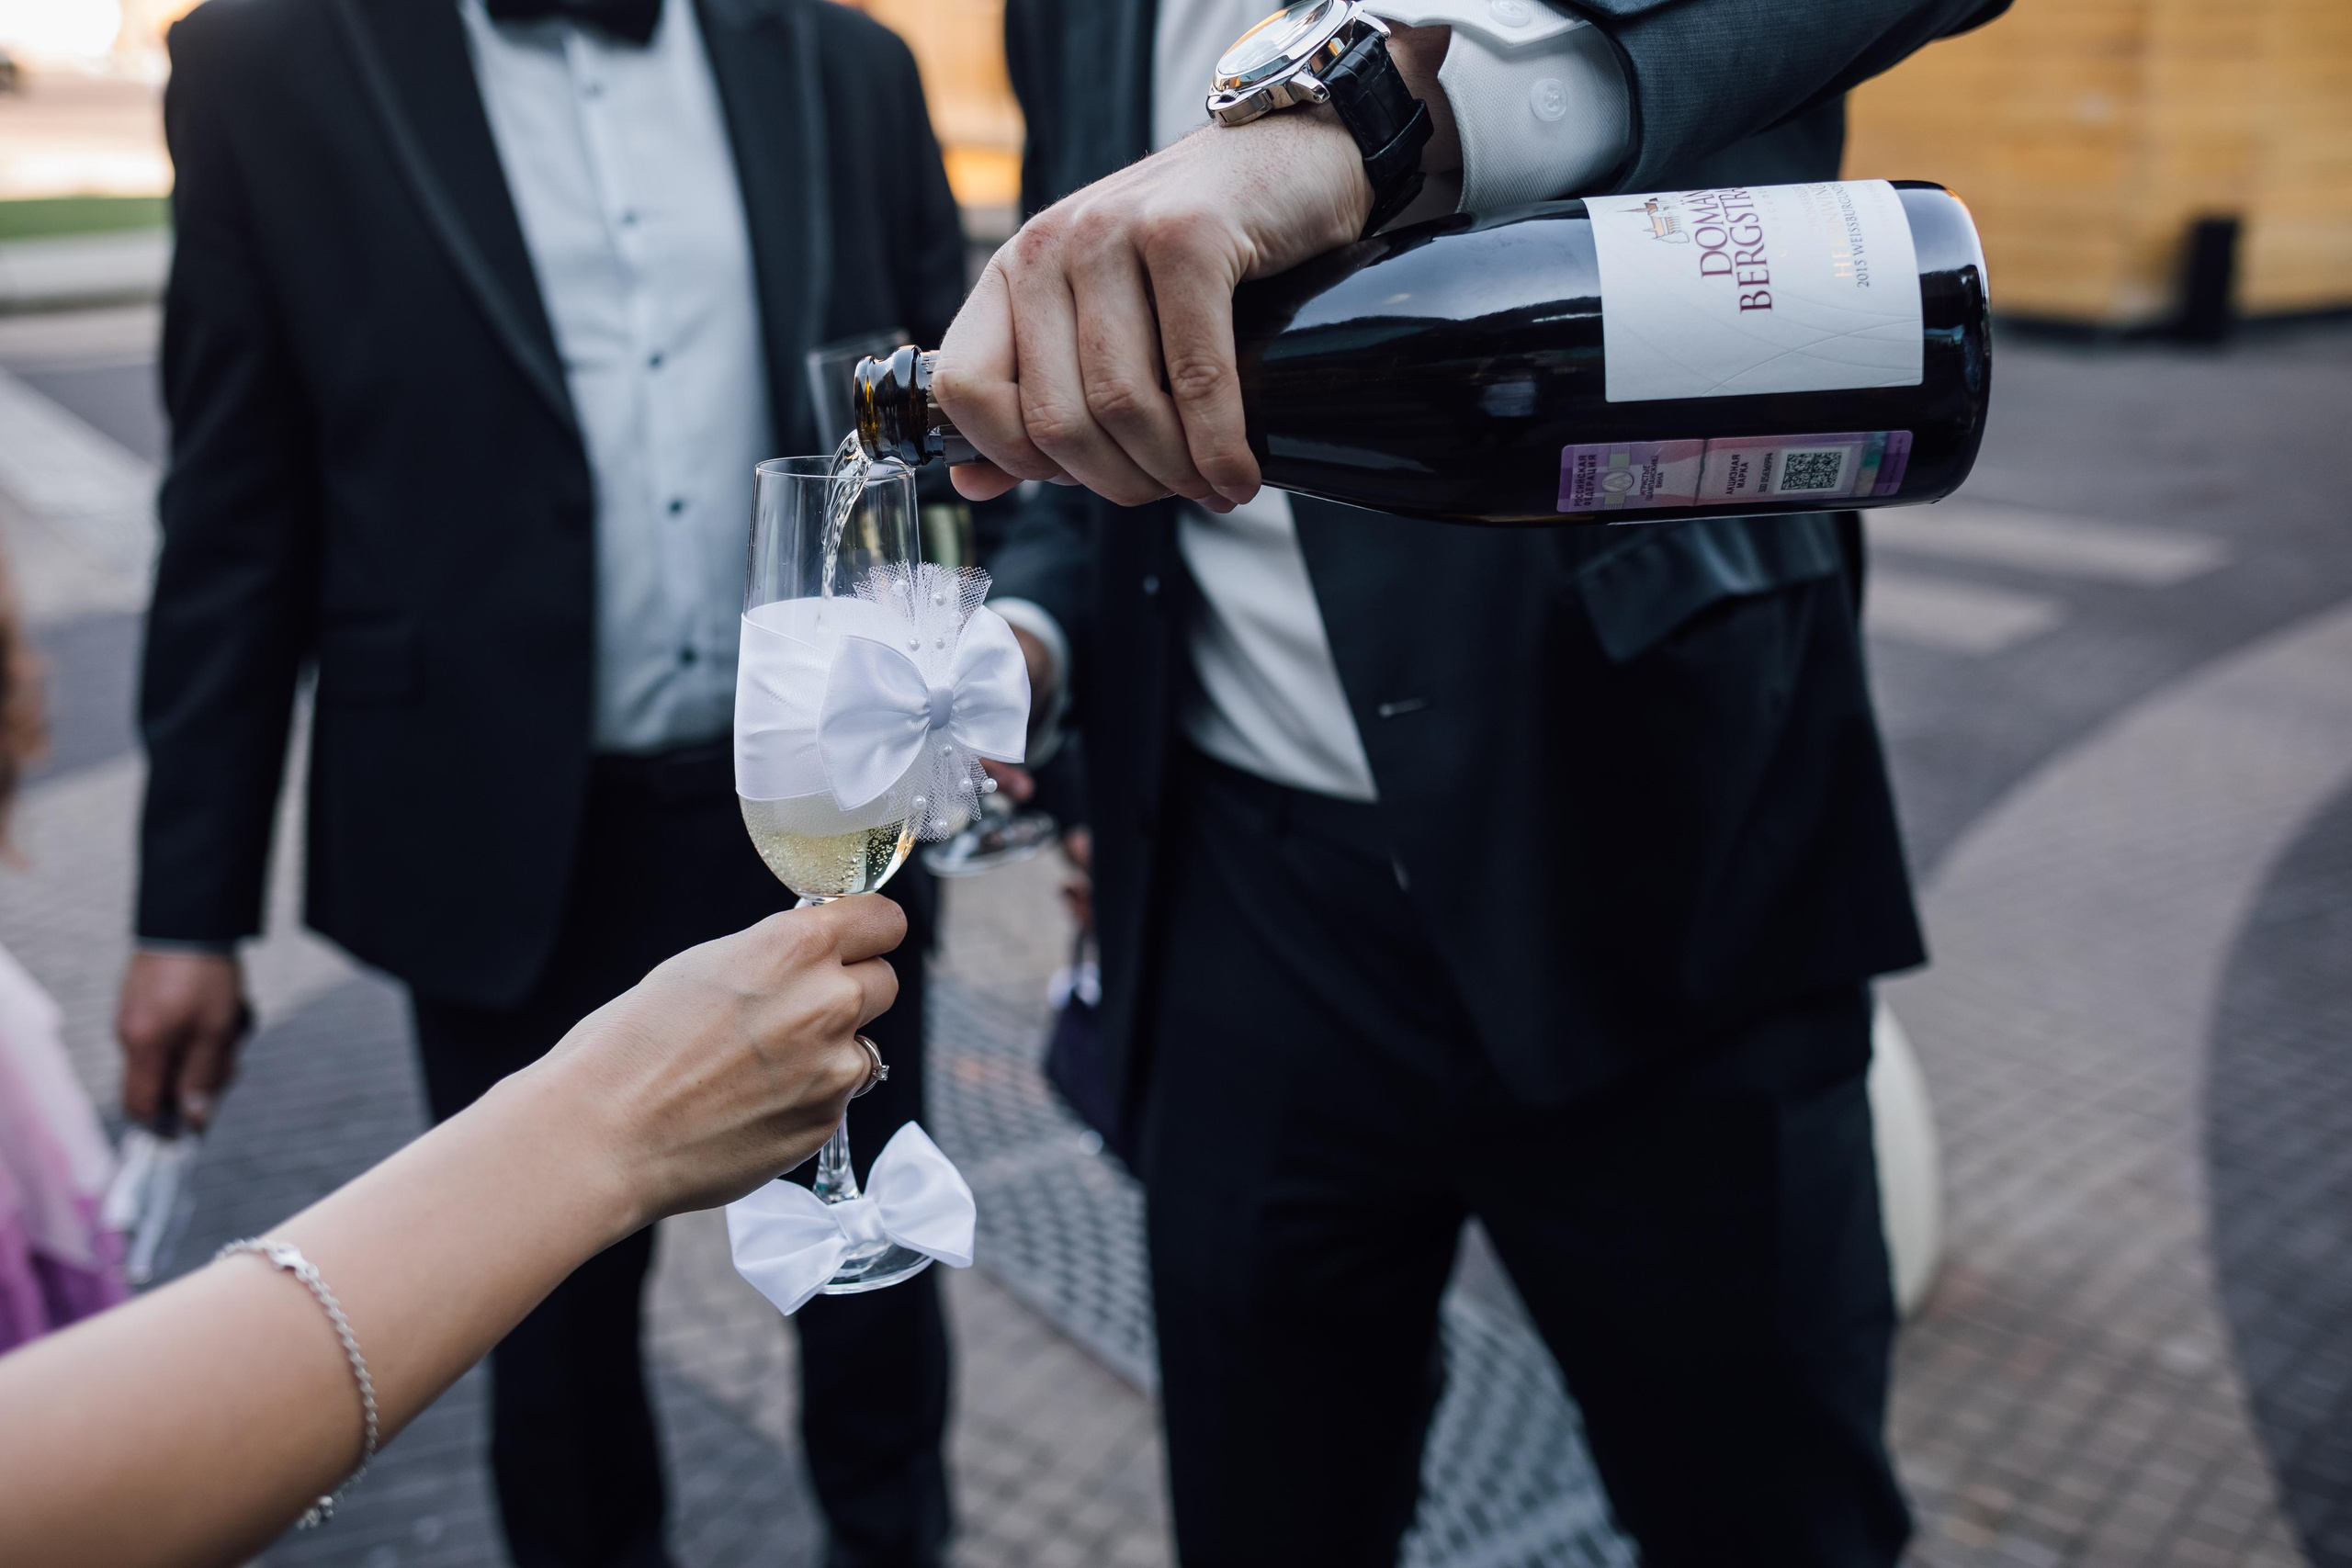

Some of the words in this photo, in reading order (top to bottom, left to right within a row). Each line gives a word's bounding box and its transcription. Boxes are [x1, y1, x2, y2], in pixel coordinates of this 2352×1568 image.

[1853, 259, 1871, 288] 2015
[1574, 455, 1588, 507] РОССИЙСКАЯ
[1584, 454, 1598, 506] ФЕДЕРАЦИЯ
[1639, 465, 1651, 496] ИГРИСТЫЕ
[1654, 471, 1665, 489] ВИНА
[1725, 454, 1741, 495] АКЦИЗНАЯ
[1736, 462, 1749, 489] МАРКА
